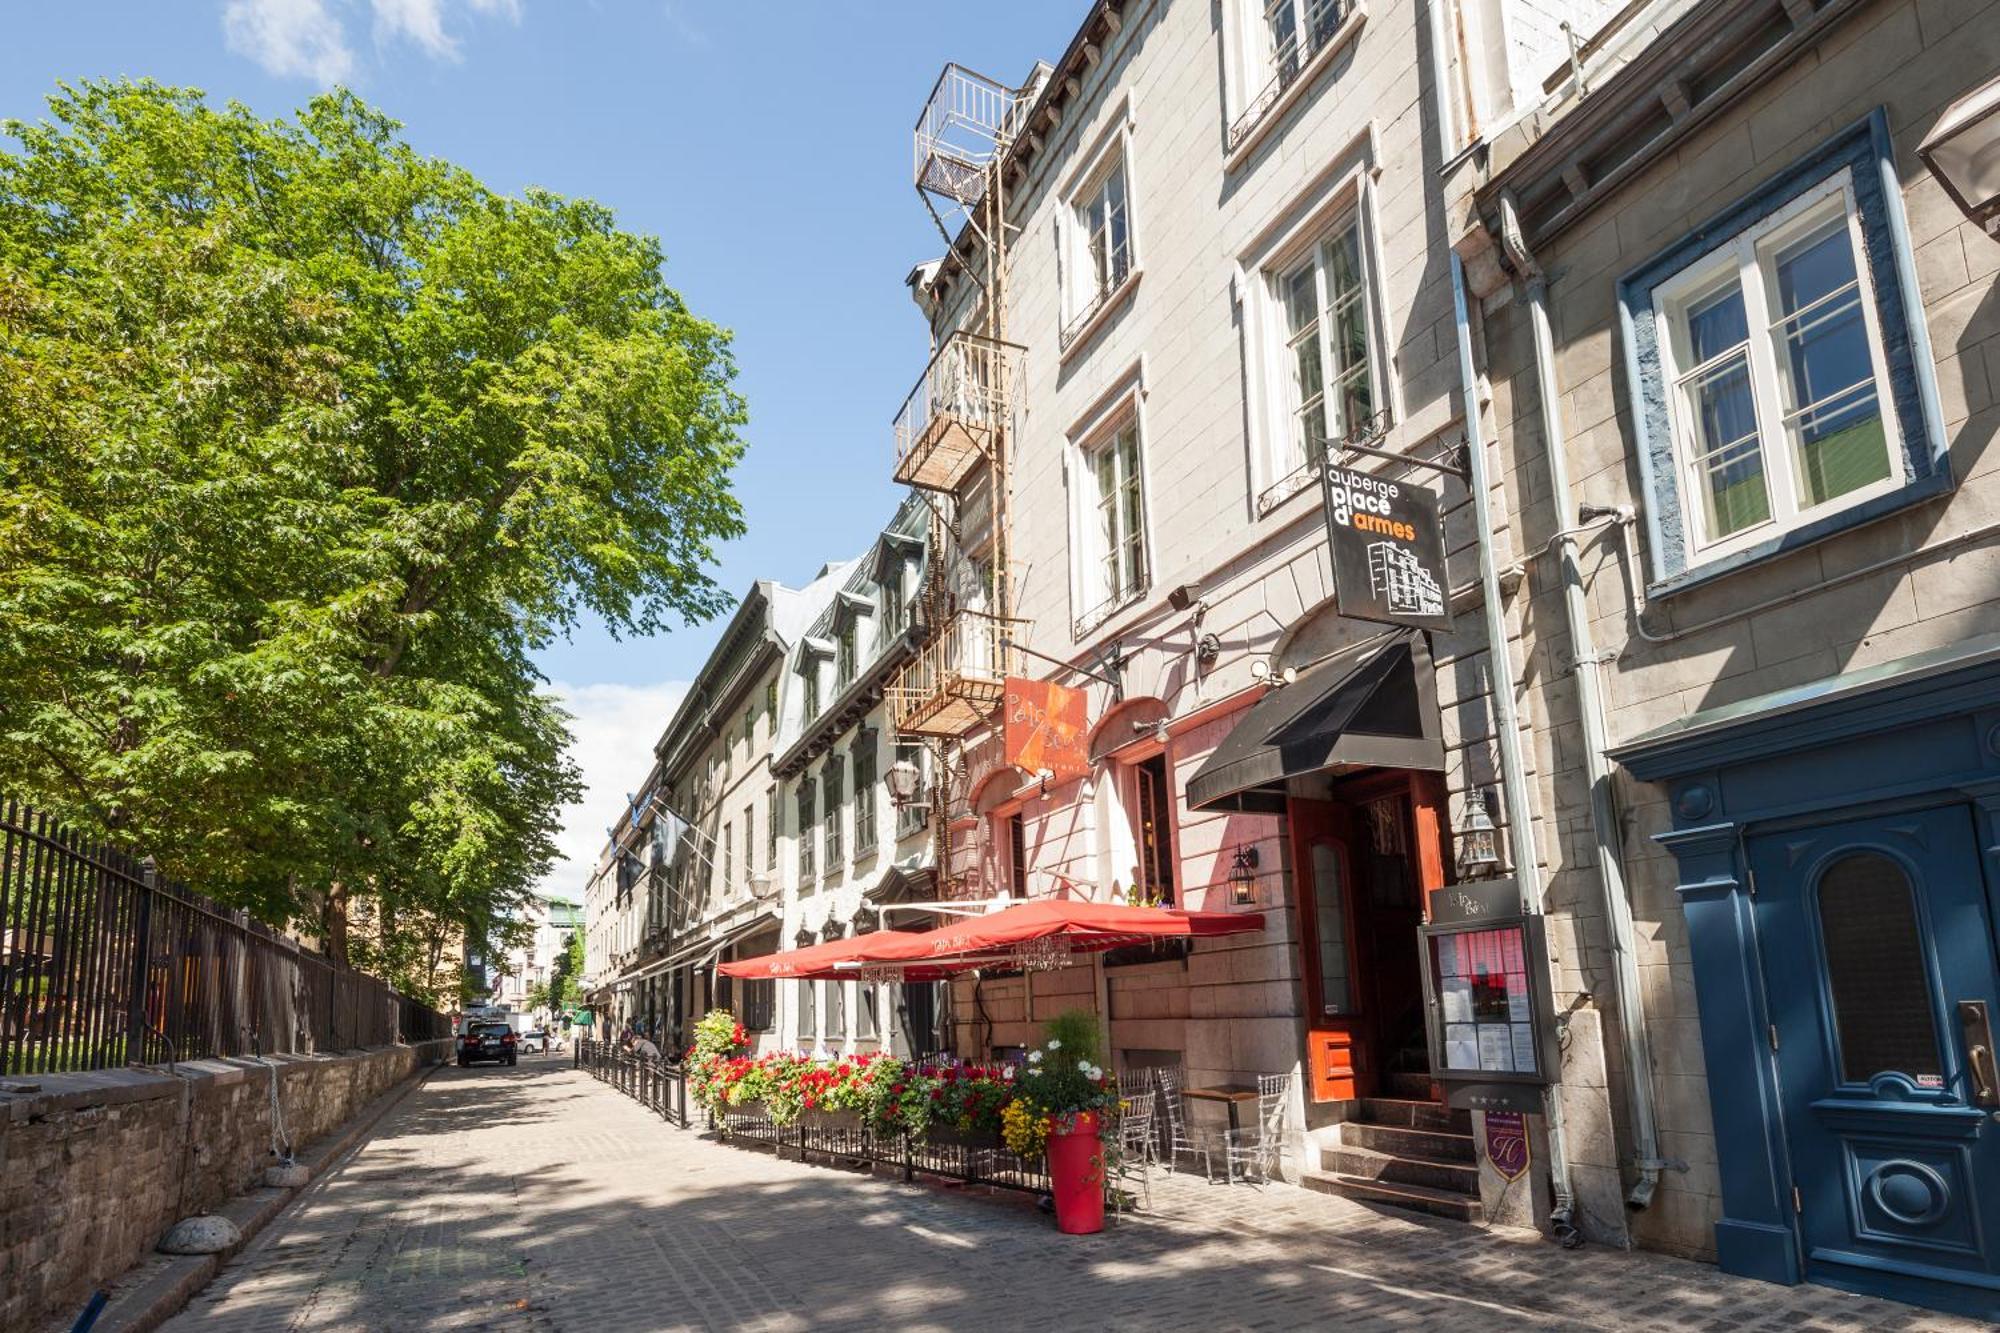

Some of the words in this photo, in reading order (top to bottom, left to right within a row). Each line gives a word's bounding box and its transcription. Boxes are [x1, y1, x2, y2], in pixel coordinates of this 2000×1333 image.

[1328, 470, 1399, 499] auberge
[1332, 486, 1391, 515] place
[1334, 504, 1416, 541] d'armes
